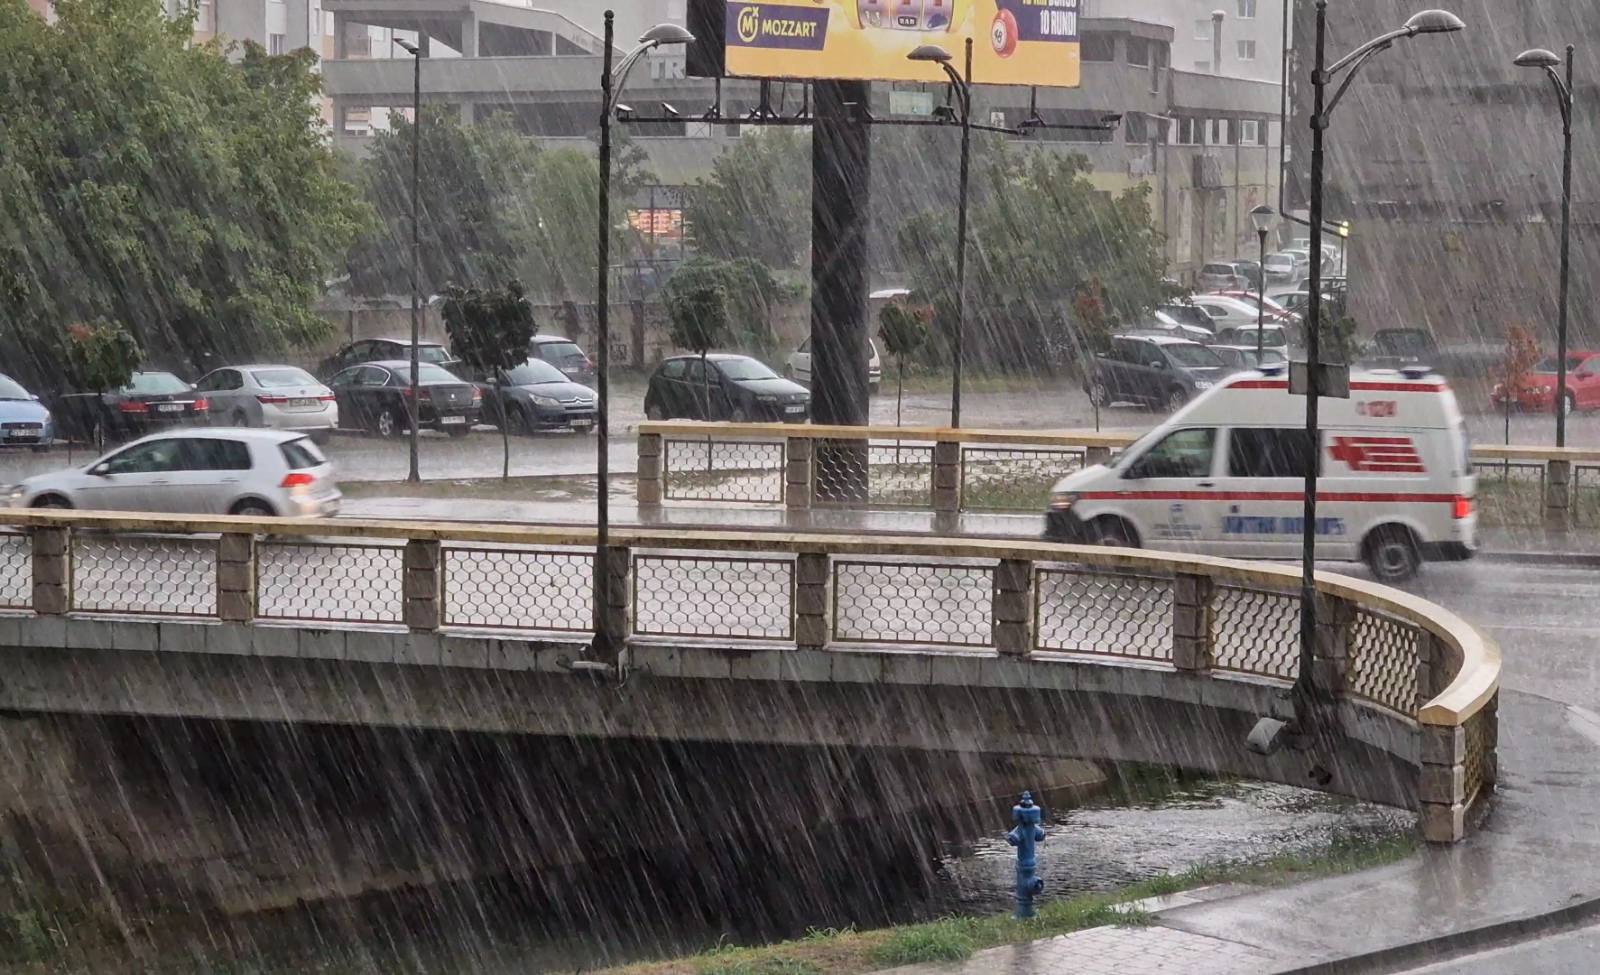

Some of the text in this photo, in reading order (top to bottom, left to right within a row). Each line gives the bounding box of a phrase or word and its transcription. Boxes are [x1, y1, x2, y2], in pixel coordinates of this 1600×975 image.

[762, 19, 817, 37] MOZZART
[1040, 9, 1077, 36] 10 RUNDI
